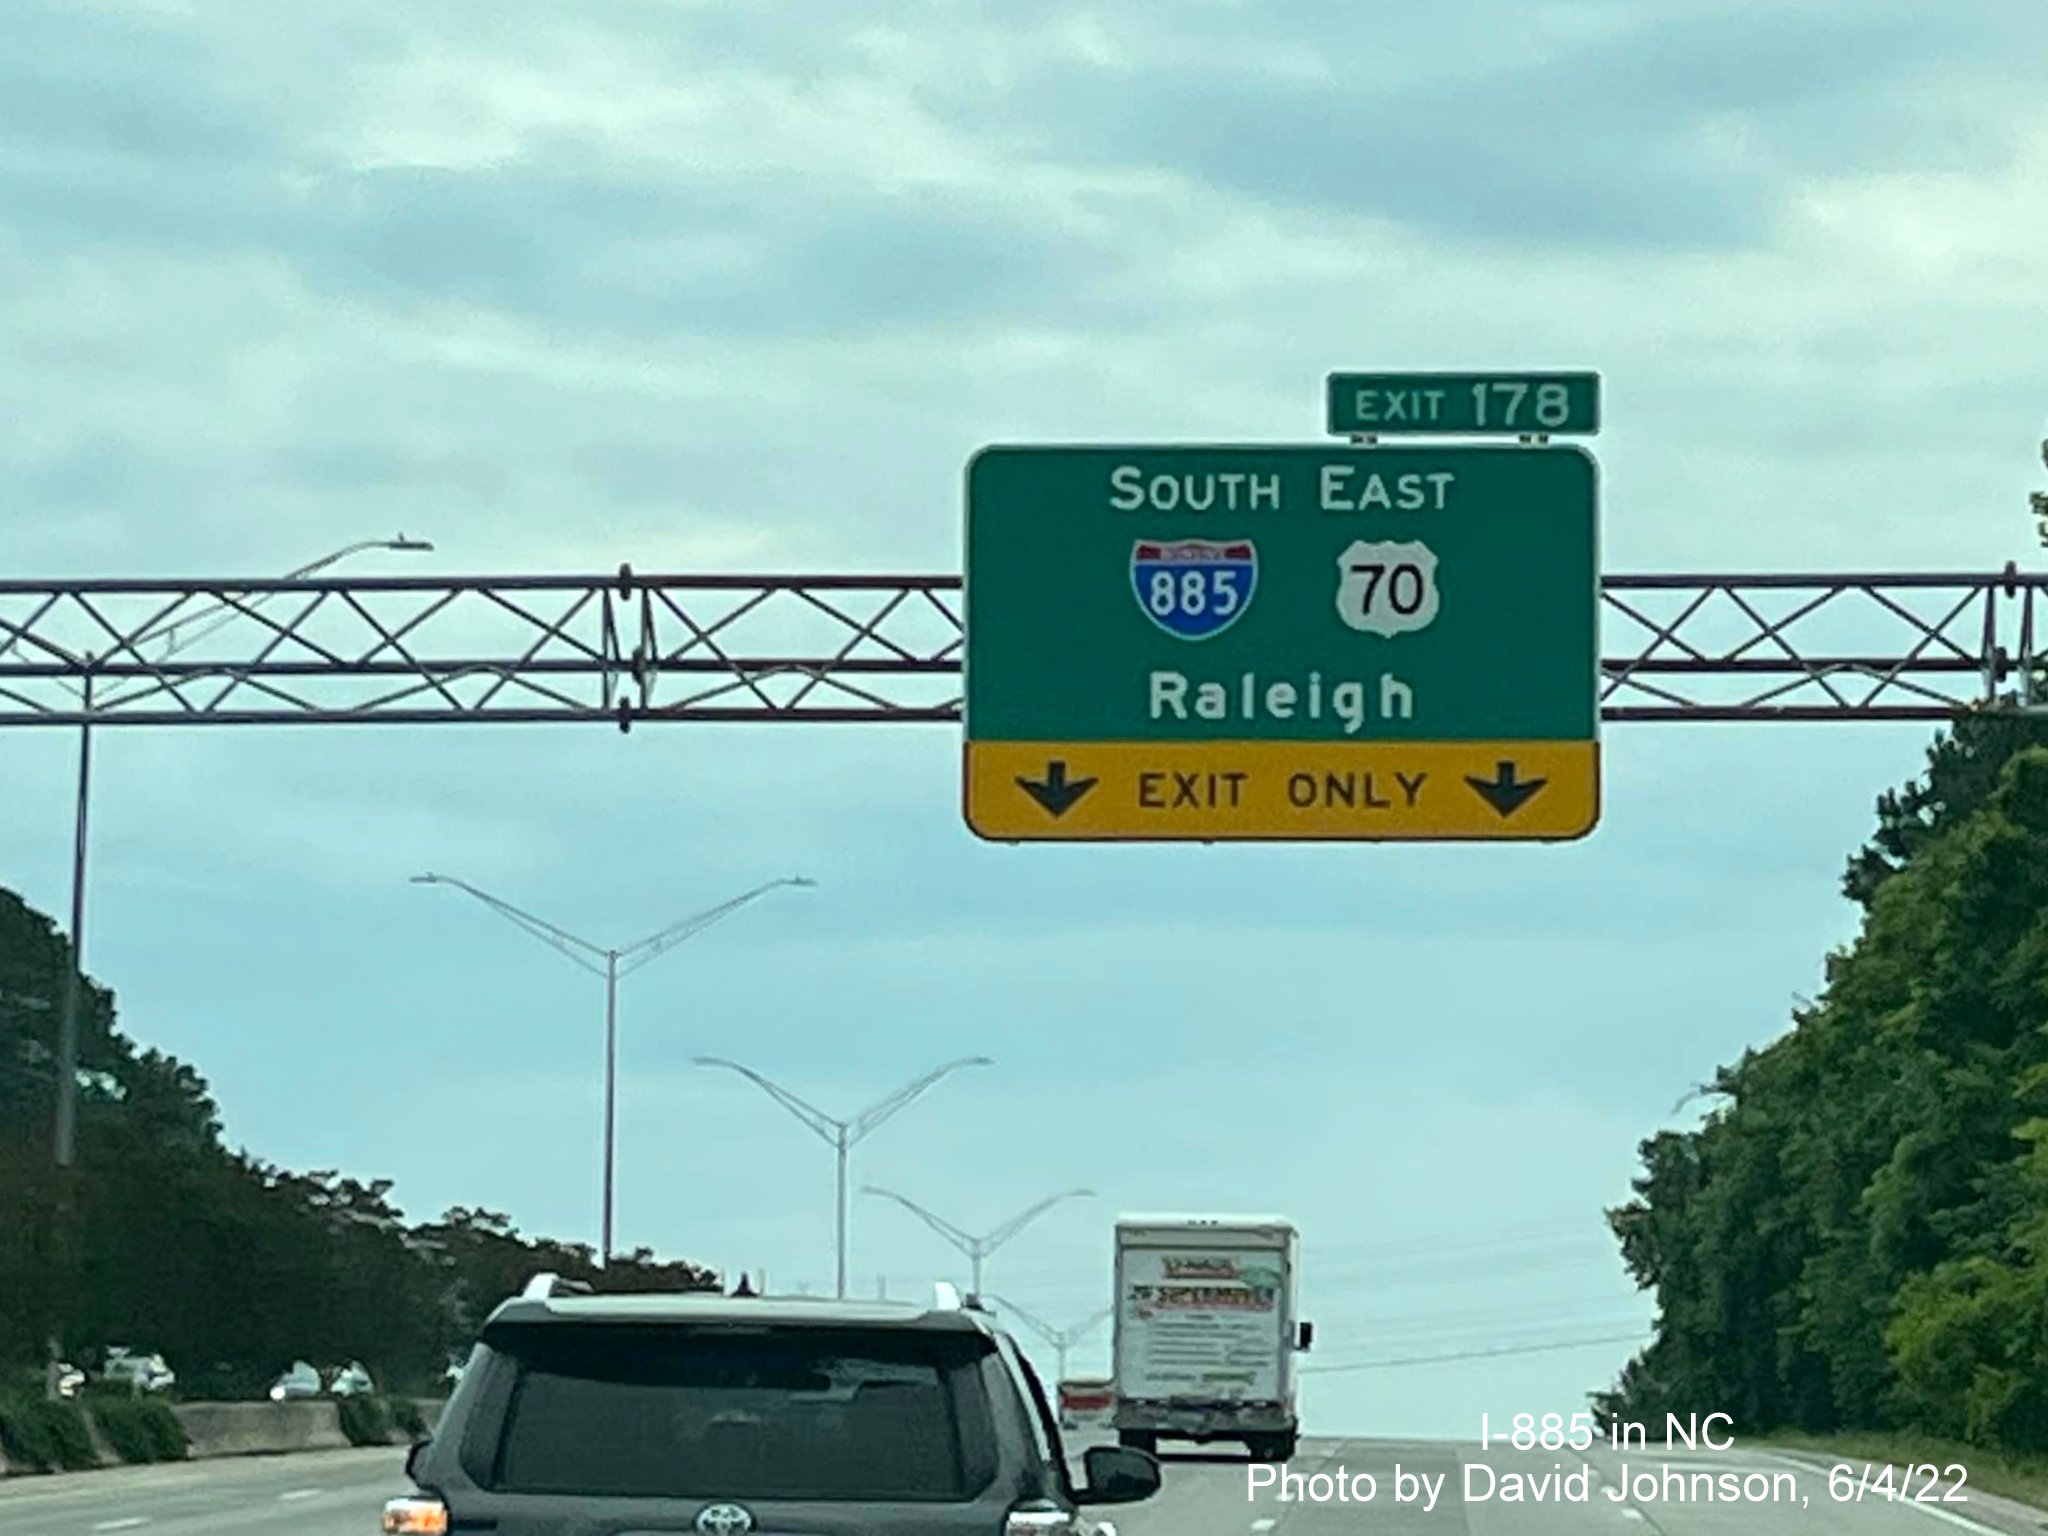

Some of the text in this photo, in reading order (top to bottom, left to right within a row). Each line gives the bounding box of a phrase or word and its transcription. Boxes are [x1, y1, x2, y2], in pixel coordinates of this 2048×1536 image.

[1356, 383, 1569, 427] EXIT 178
[1110, 465, 1455, 511] SOUTH EAST
[1150, 570, 1239, 616] 885
[1351, 563, 1424, 616] 70
[1149, 671, 1413, 733] Raleigh
[1138, 771, 1428, 809] EXIT ONLY
